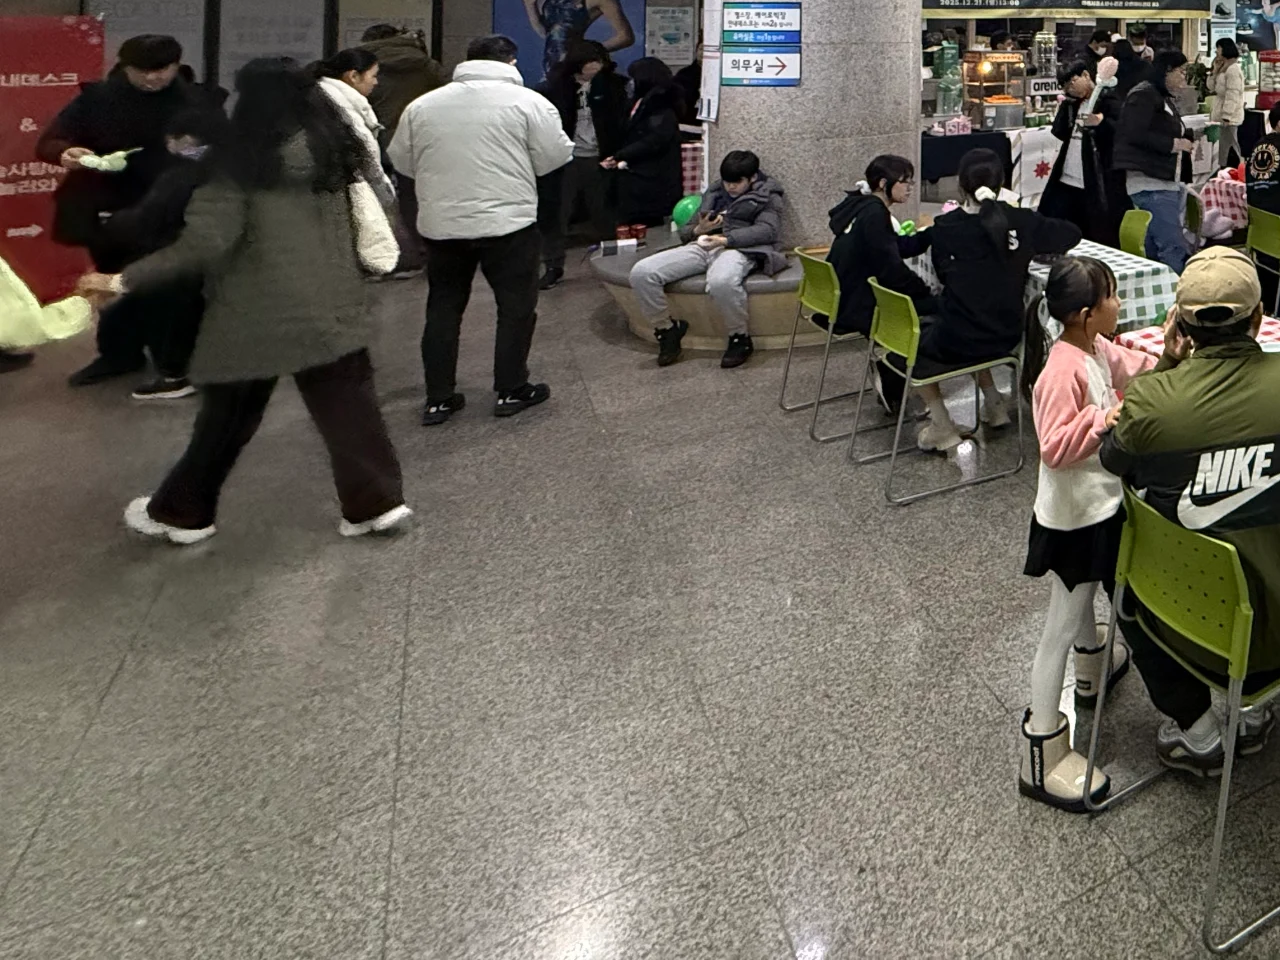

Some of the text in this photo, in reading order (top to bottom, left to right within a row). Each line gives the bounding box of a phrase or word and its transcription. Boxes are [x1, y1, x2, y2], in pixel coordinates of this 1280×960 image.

[730, 58, 764, 73] 의무실
[20, 117, 38, 132] &
[1192, 443, 1275, 496] NIKE
